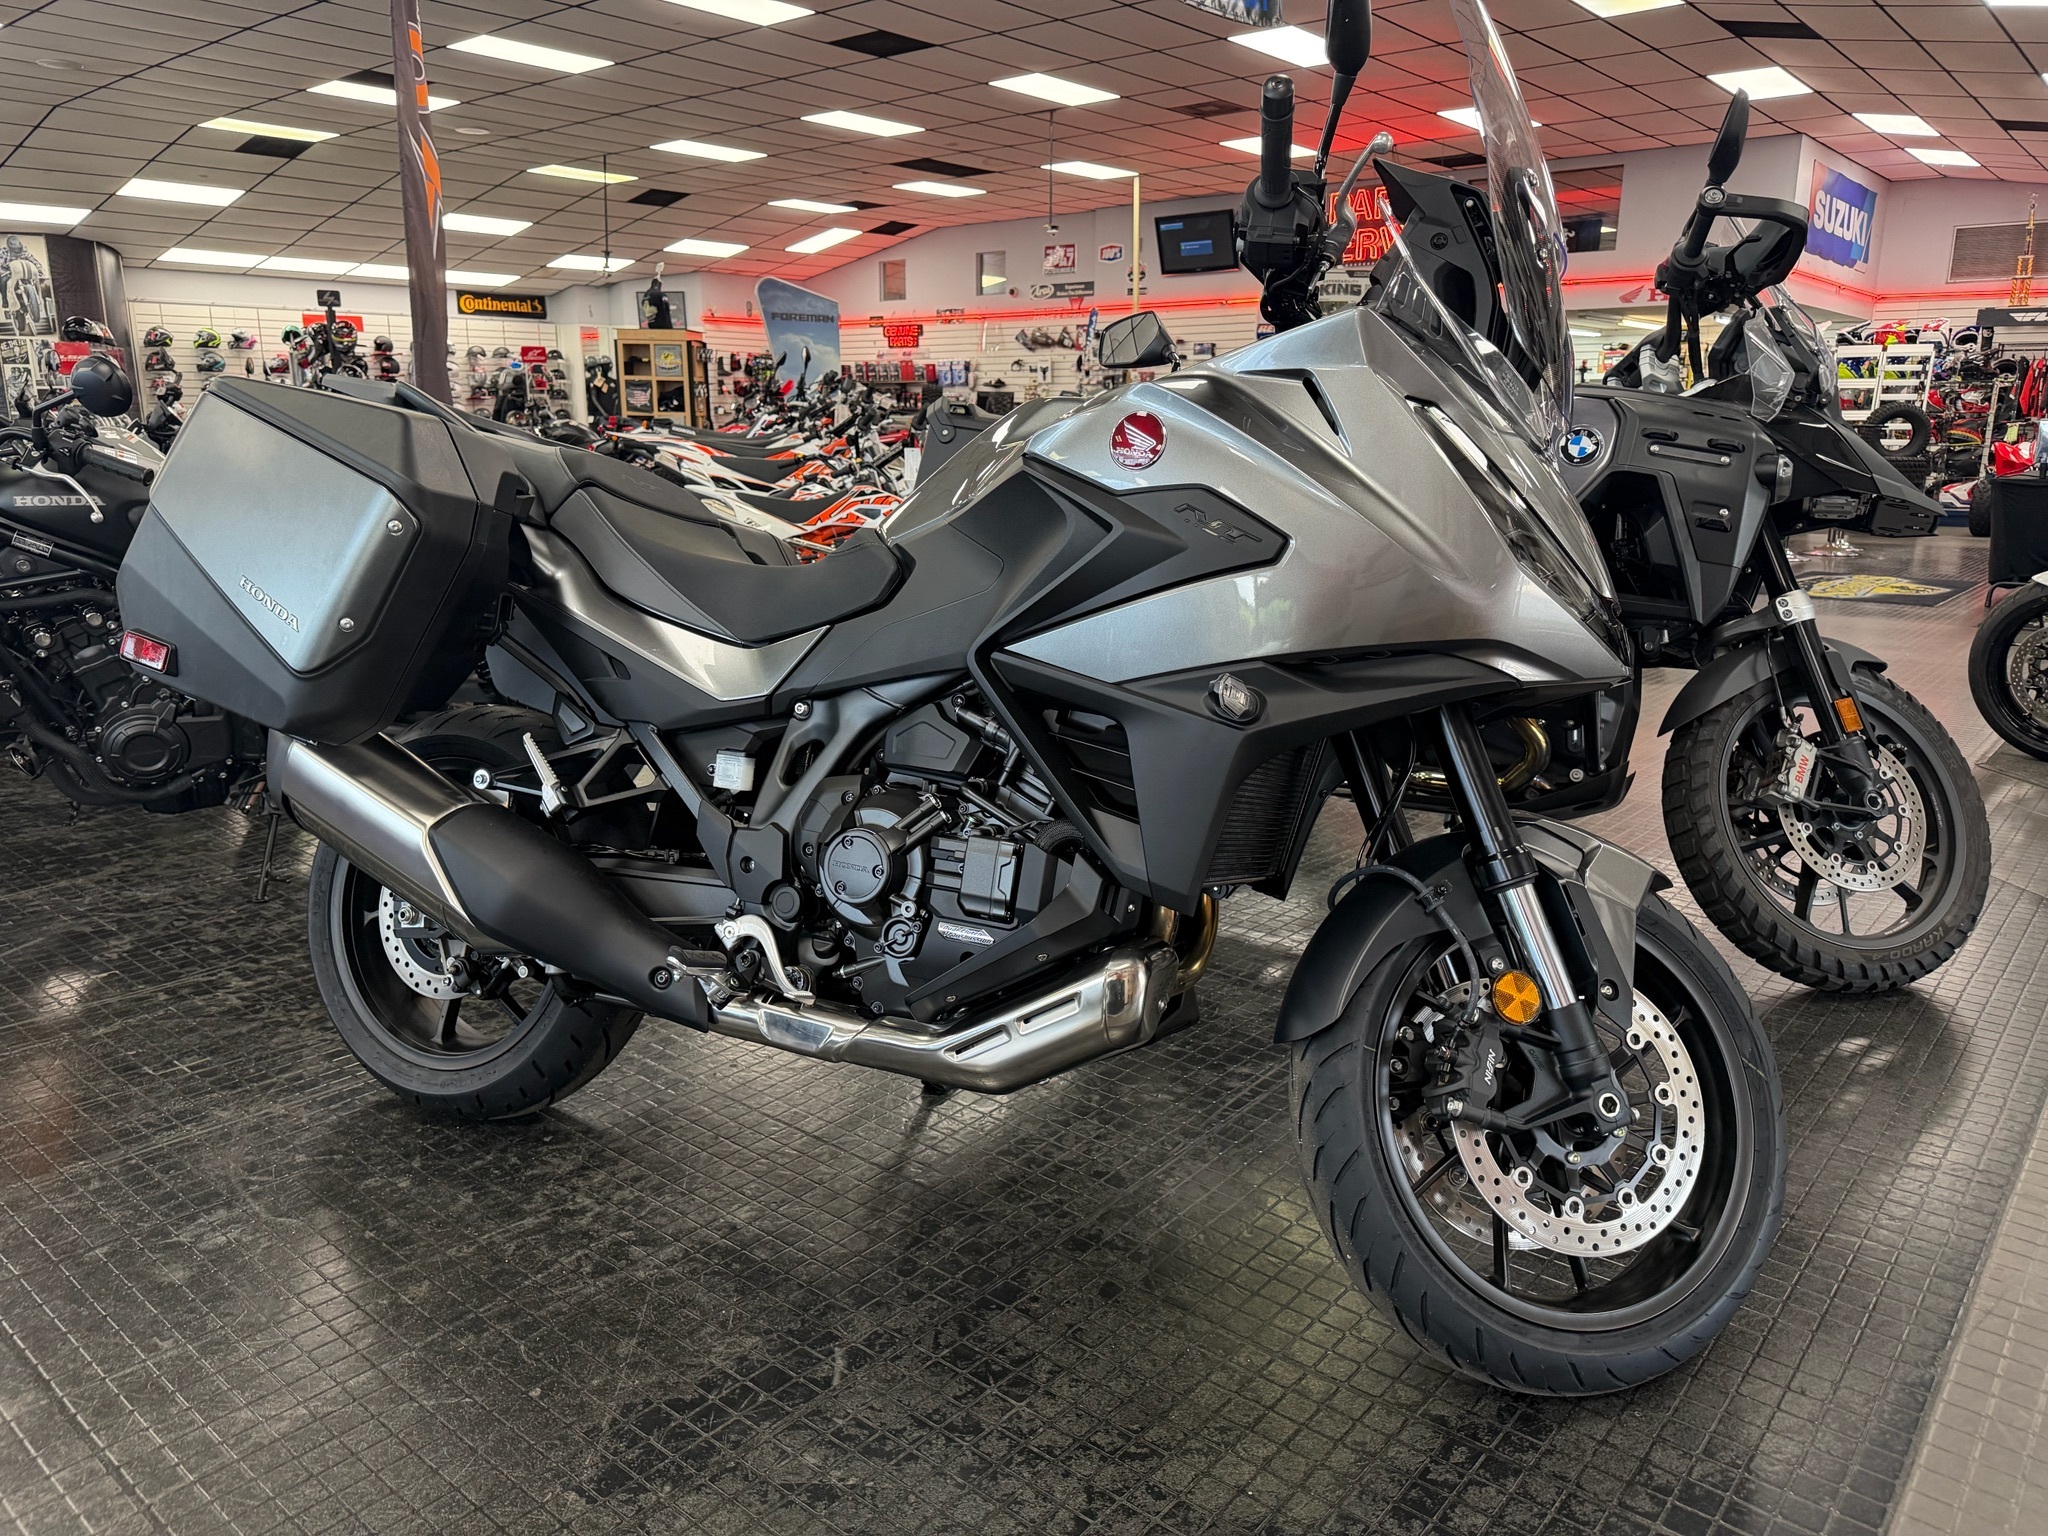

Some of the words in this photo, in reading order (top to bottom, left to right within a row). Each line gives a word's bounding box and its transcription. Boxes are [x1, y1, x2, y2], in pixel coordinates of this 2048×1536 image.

[1813, 190, 1868, 247] SUZUKI
[459, 294, 532, 314] Continental
[771, 312, 835, 323] FOREMAN
[884, 325, 919, 337] GENUINE
[889, 336, 915, 347] PARTS
[13, 495, 106, 507] HONDA
[238, 574, 300, 634] HONDA
[1794, 754, 1809, 784] BMW
[832, 860, 870, 874] HONDA
[1889, 926, 1945, 960] KAROO
